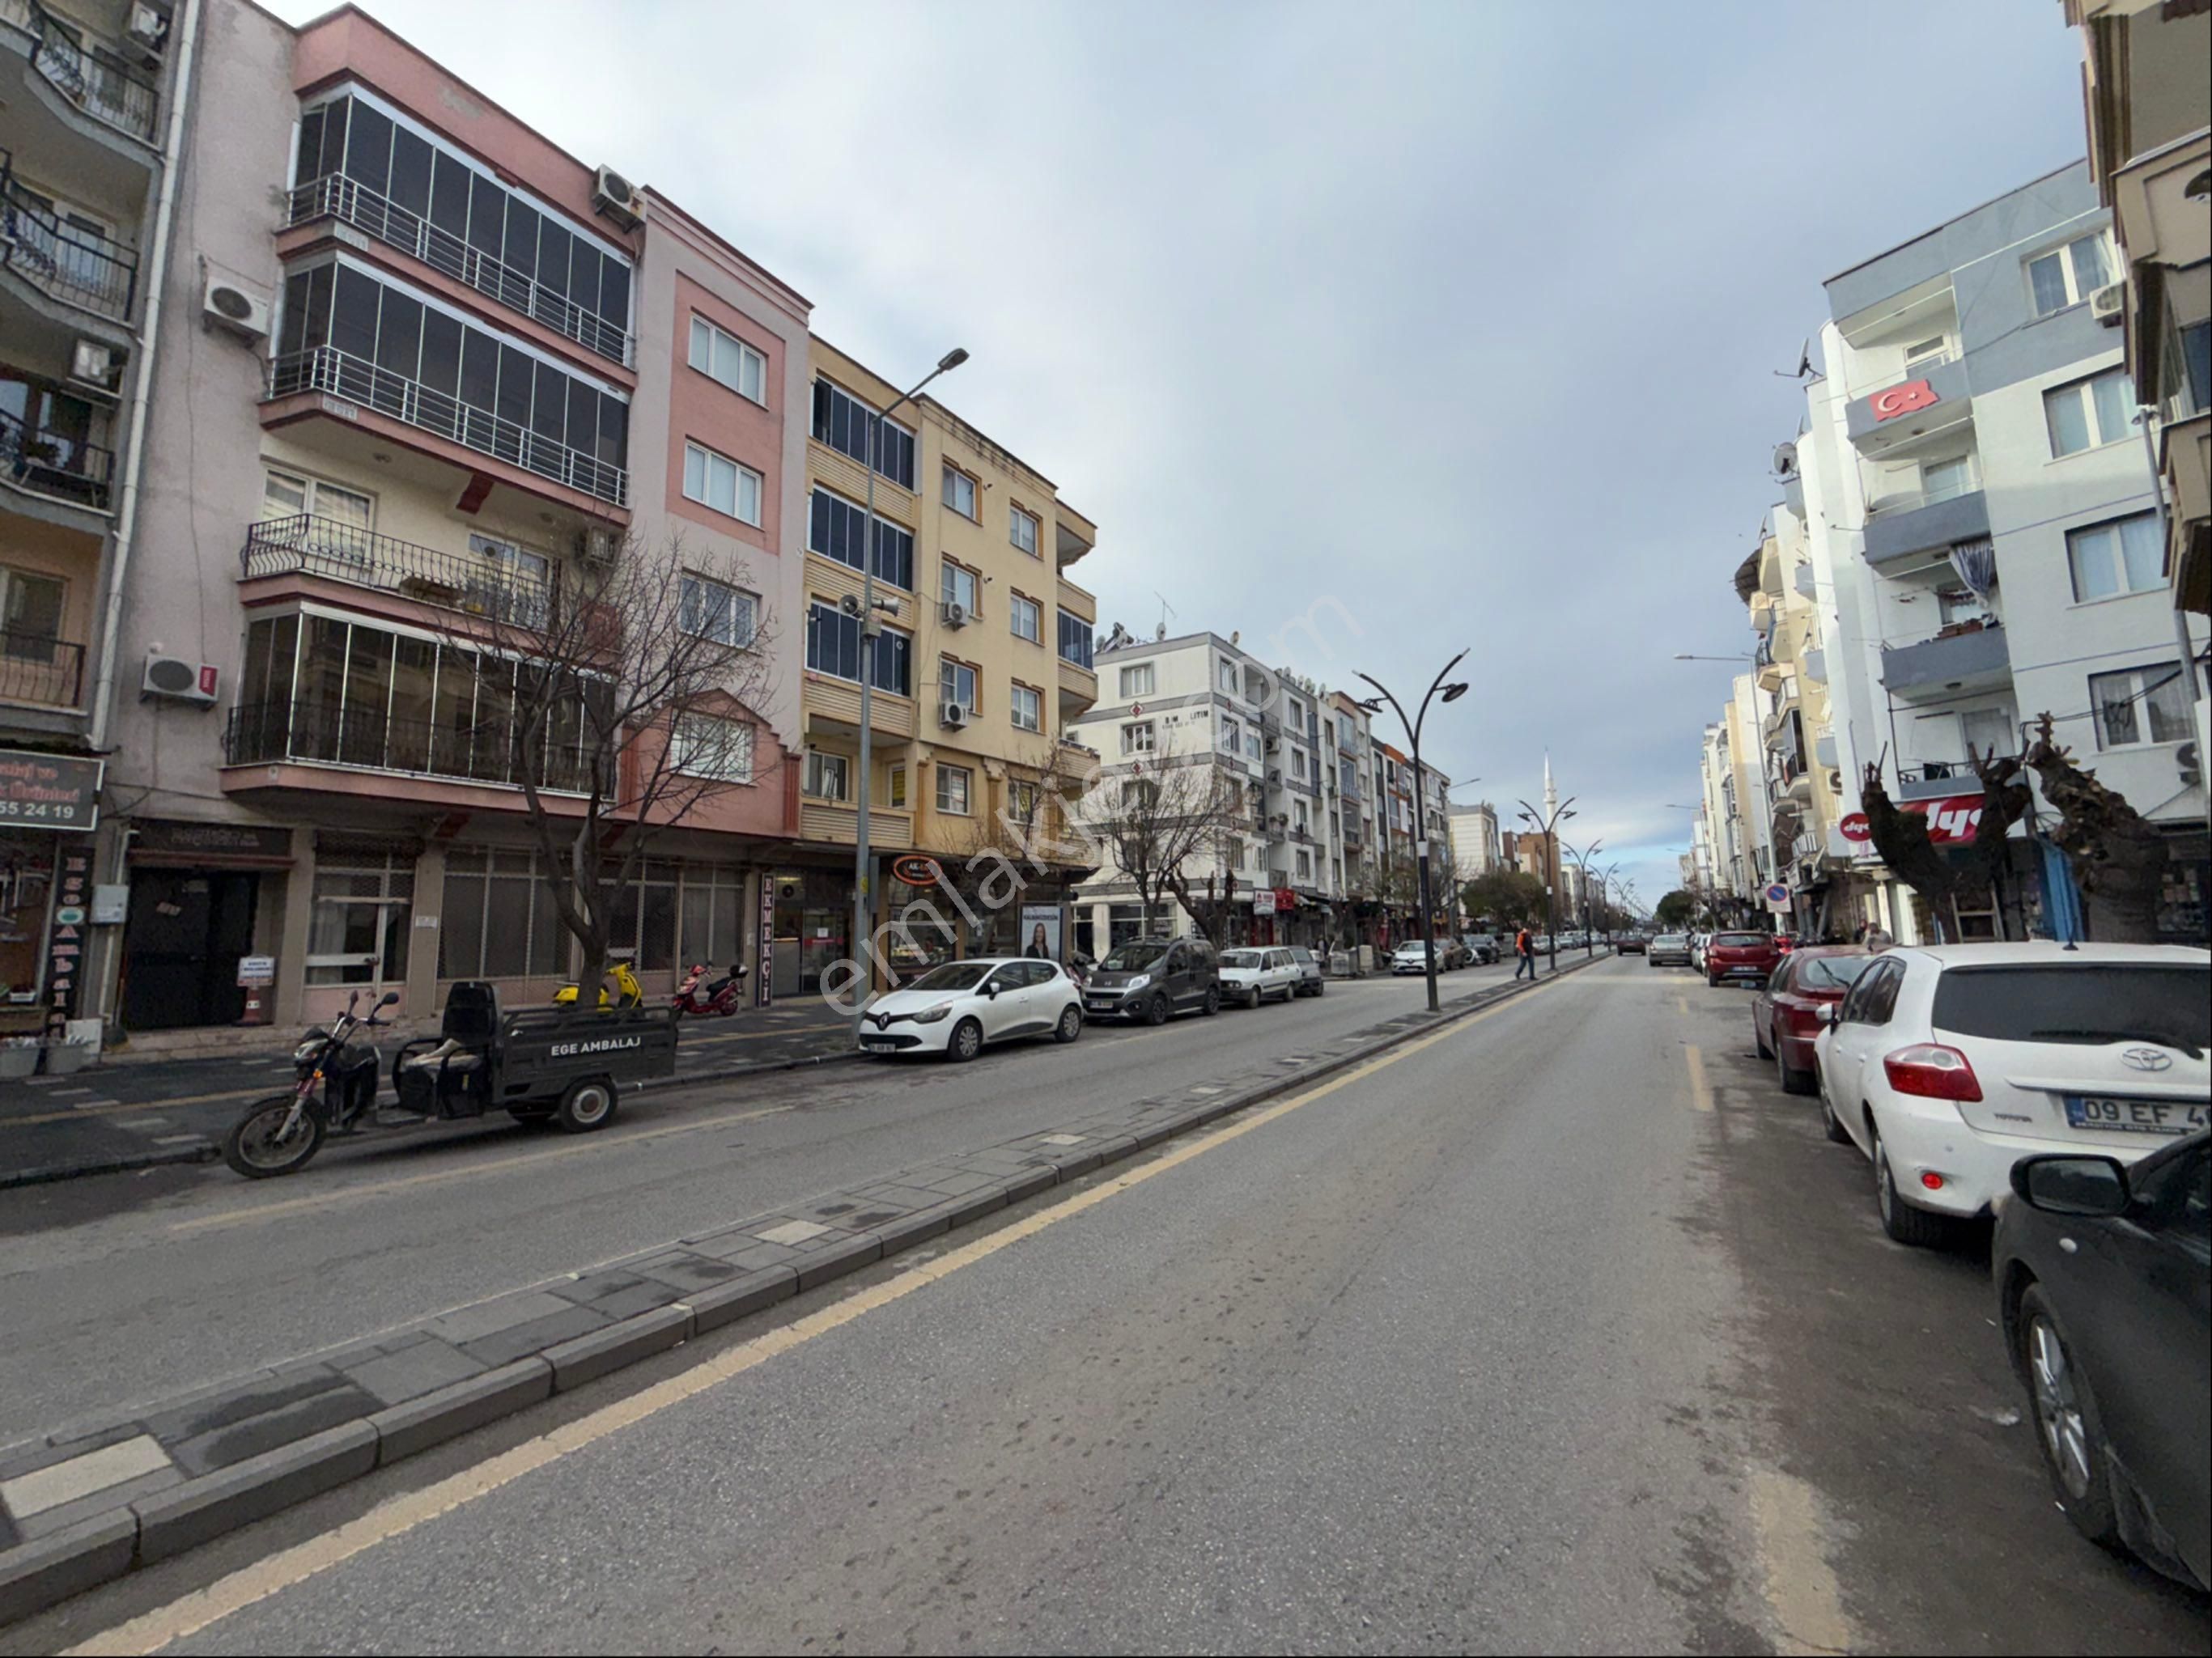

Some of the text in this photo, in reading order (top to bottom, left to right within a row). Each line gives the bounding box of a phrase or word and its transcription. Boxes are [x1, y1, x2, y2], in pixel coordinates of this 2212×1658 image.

[24, 803, 46, 816] 24
[53, 805, 74, 819] 19
[551, 1037, 641, 1056] EGE AMBALAJ
[2084, 1100, 2210, 1126] 09 EF 4
